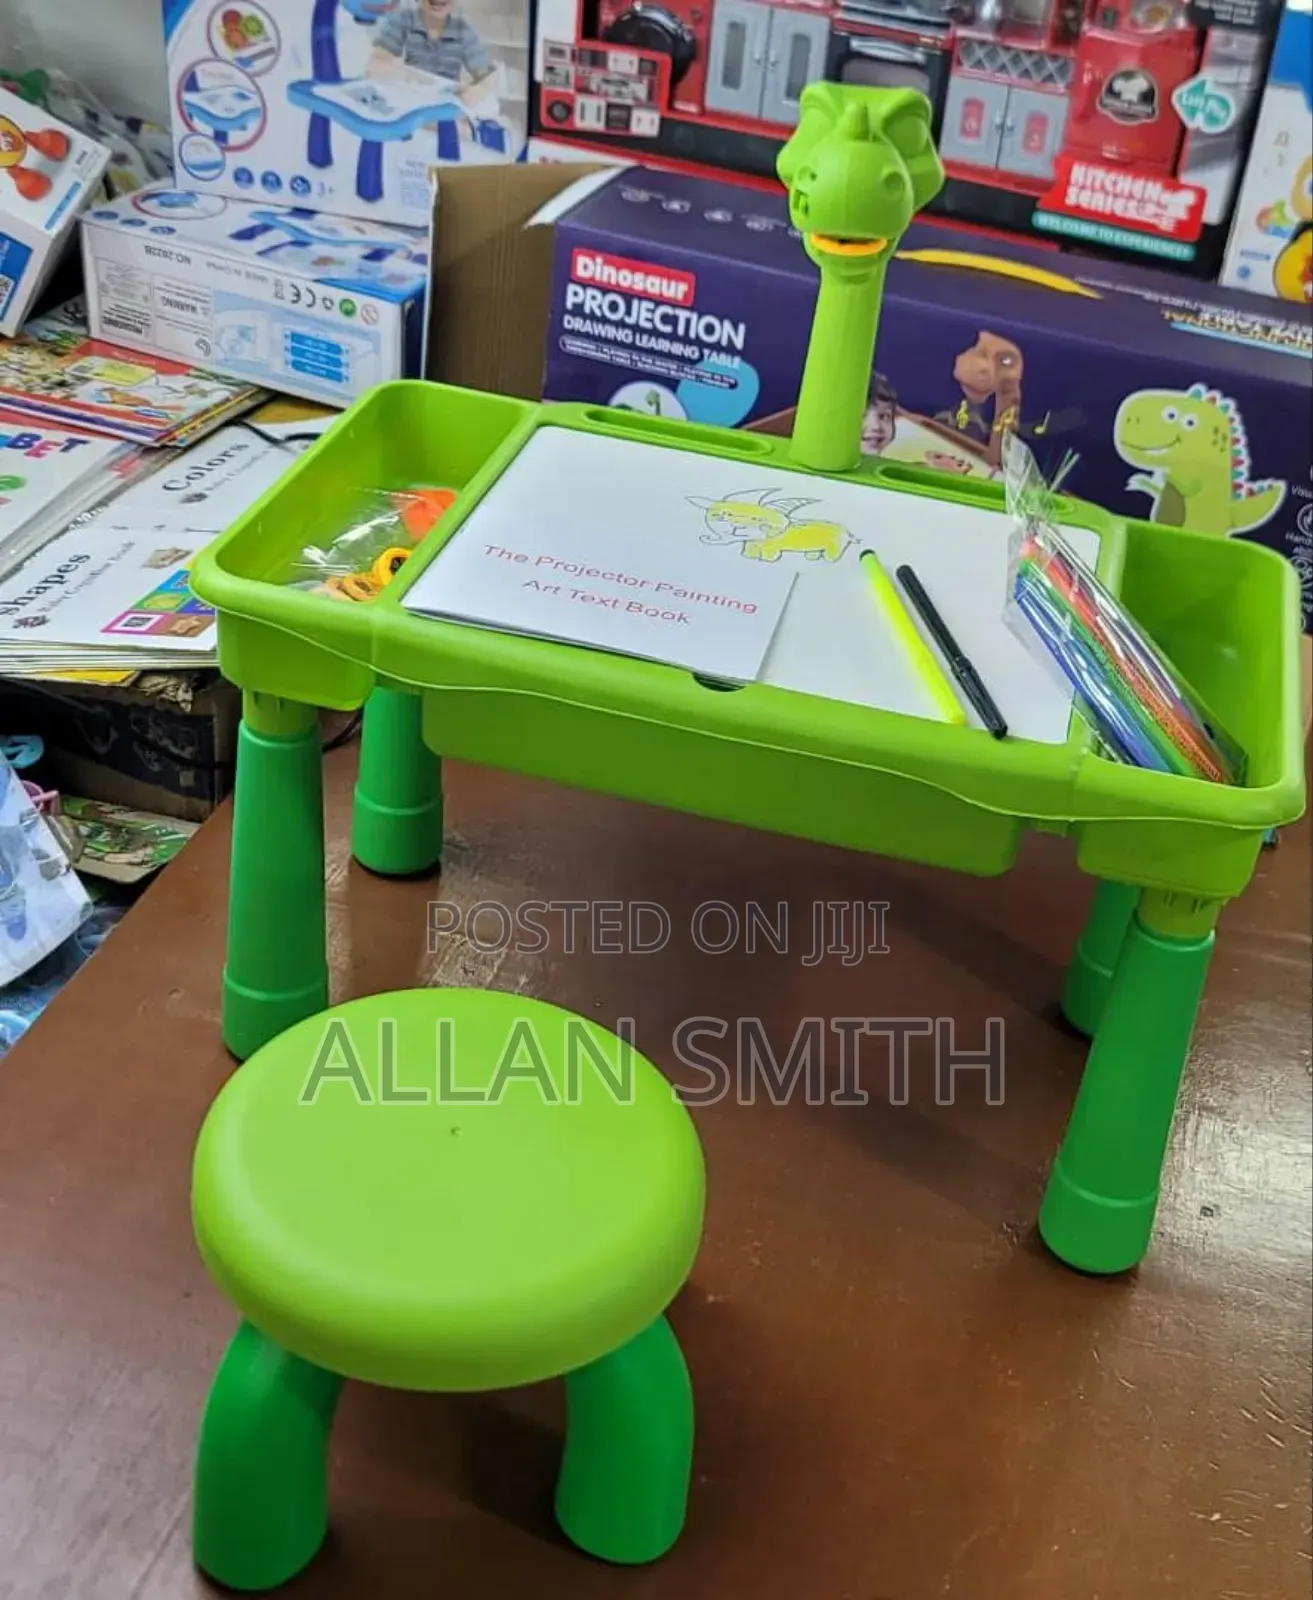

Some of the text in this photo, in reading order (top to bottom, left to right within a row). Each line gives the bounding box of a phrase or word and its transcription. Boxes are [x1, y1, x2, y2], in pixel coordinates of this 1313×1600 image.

[575, 254, 689, 301] Dinosaur
[565, 282, 746, 351] PROJECTION
[563, 314, 633, 344] DRAWING
[635, 332, 699, 360] LEARNING
[702, 349, 741, 370] TABLE
[0, 432, 90, 459] BET
[162, 443, 249, 491] Colors
[484, 544, 758, 614] The Projector Painting
[522, 579, 692, 624] Art Text Book
